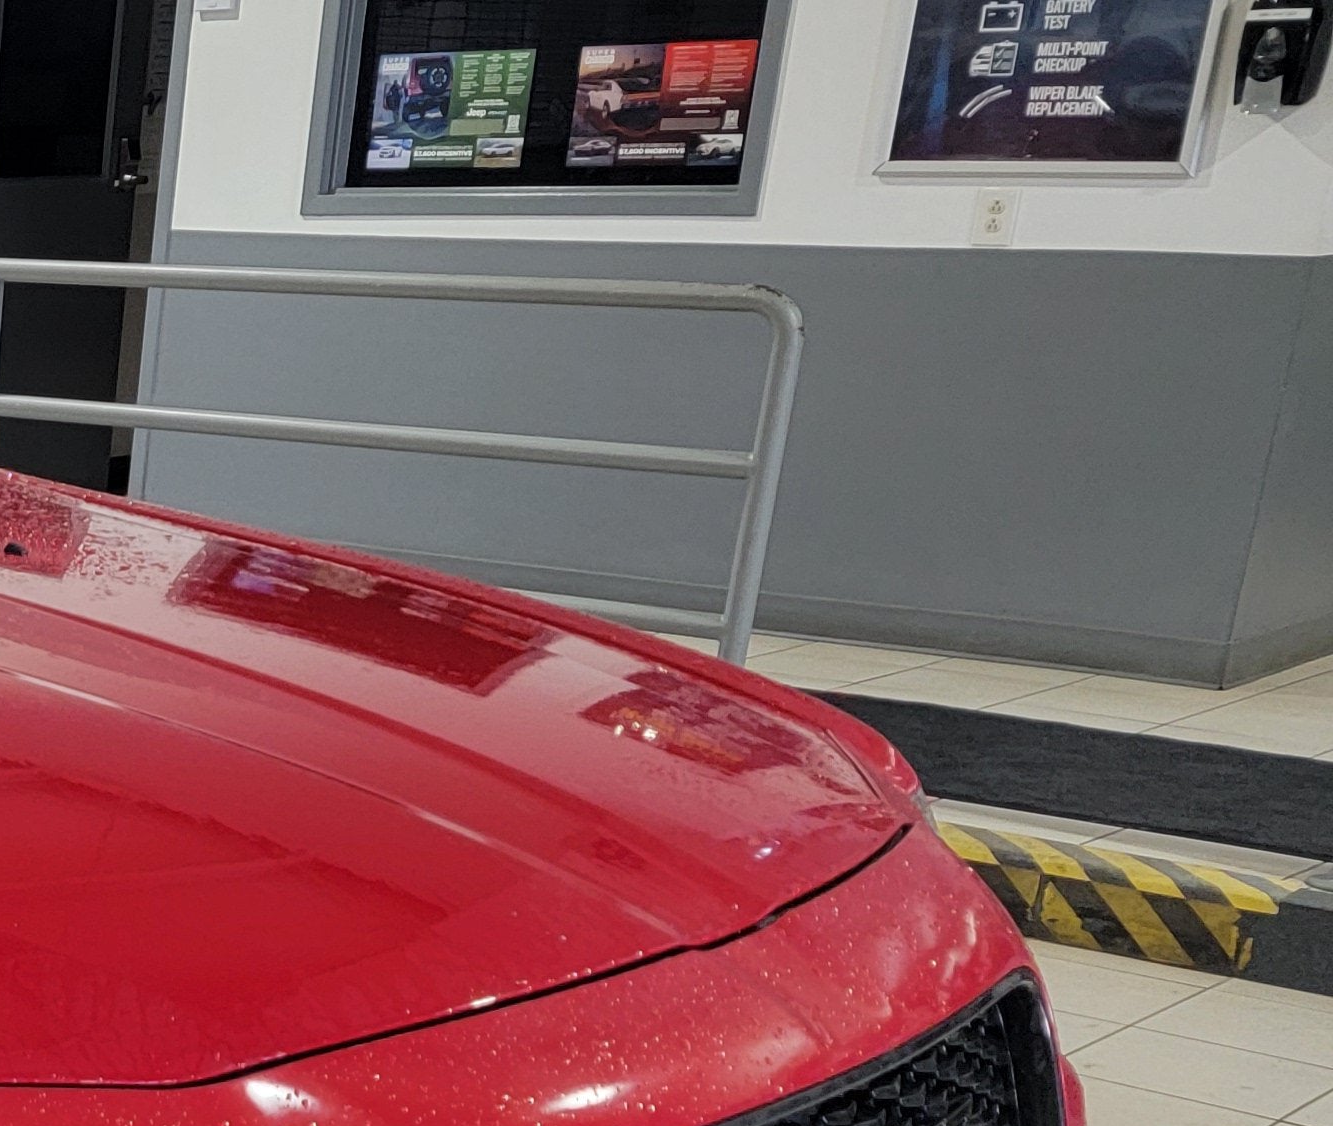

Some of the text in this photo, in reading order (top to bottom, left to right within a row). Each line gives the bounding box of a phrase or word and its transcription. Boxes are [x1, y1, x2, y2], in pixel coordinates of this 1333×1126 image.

[1045, 0, 1096, 14] BATTERY
[1044, 15, 1071, 30] TEST
[1037, 41, 1109, 57] MULTI-POINT
[1034, 57, 1087, 73] CHECKUP
[1029, 85, 1105, 101] WIPER BLADE
[1025, 101, 1106, 116] REPLACEMENT
